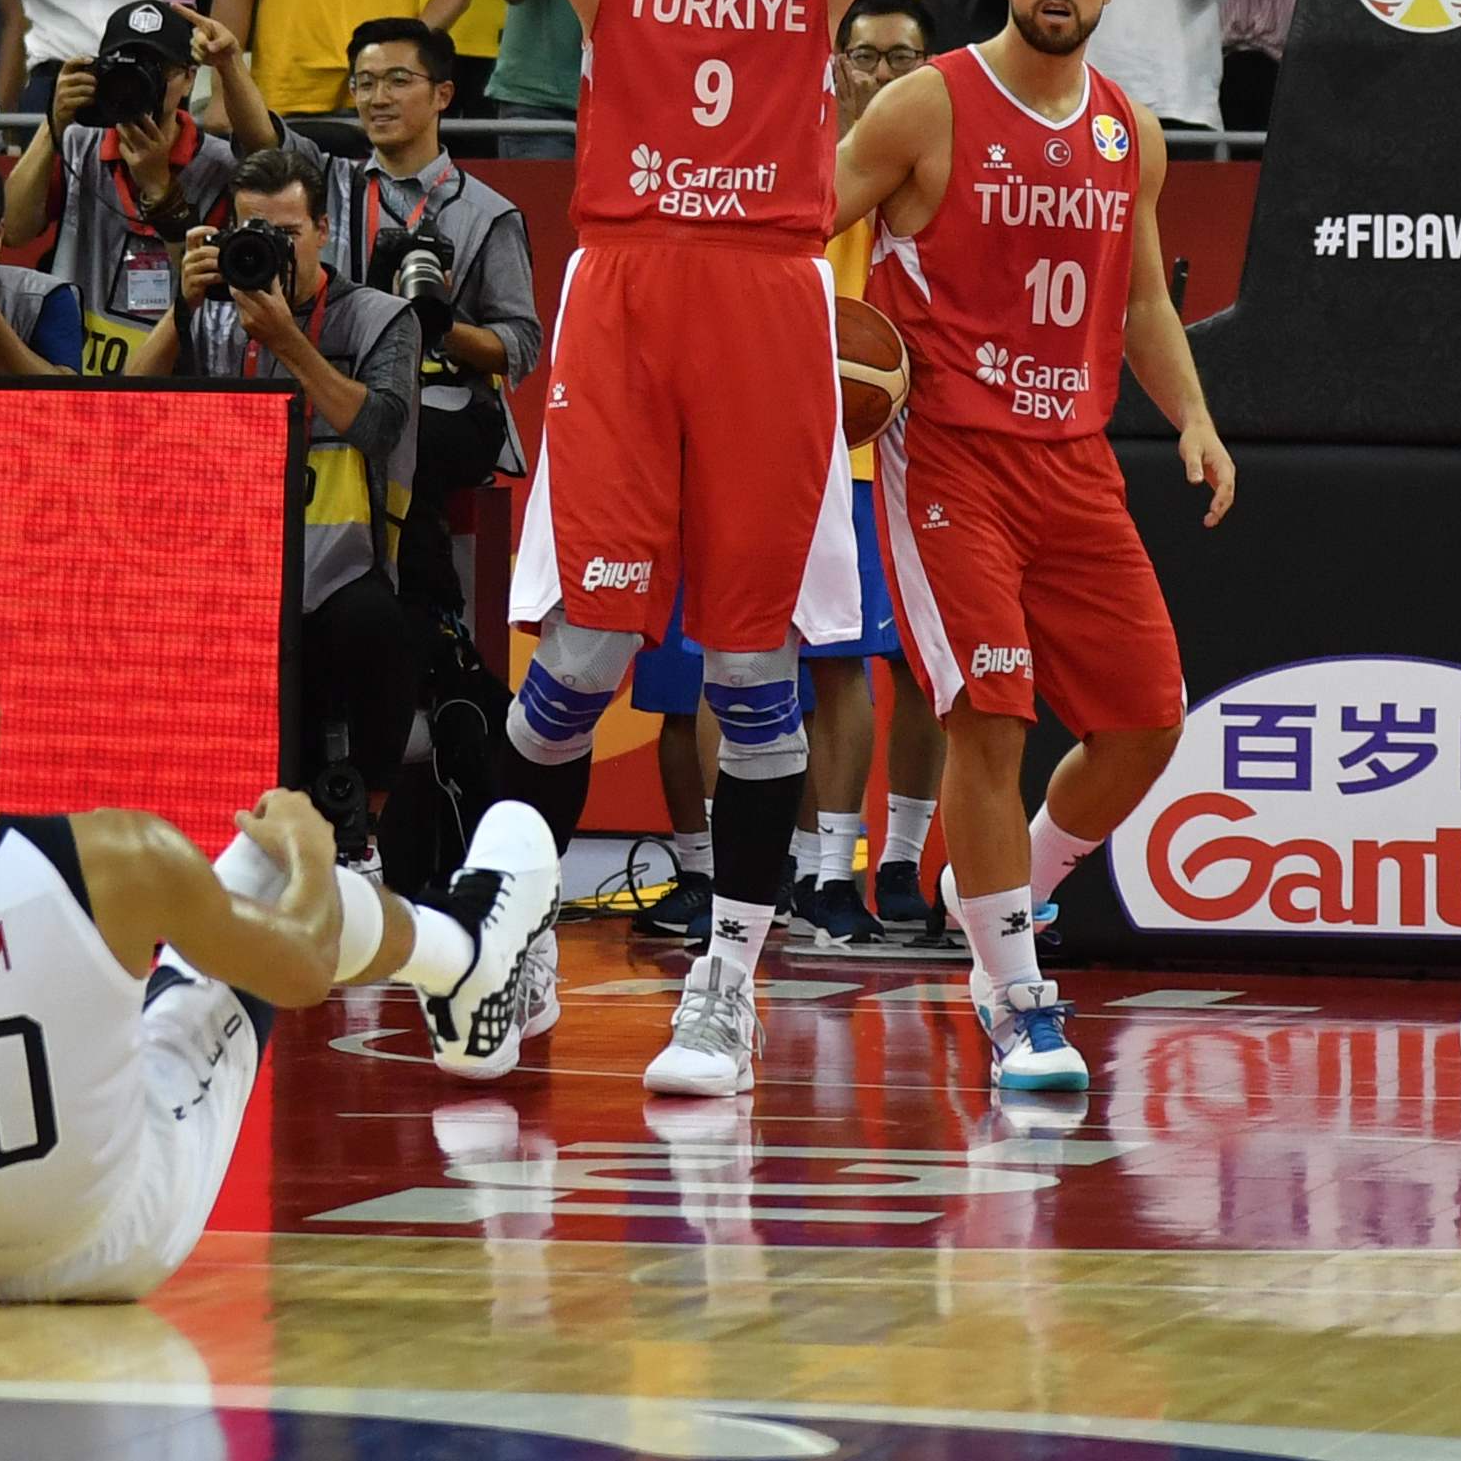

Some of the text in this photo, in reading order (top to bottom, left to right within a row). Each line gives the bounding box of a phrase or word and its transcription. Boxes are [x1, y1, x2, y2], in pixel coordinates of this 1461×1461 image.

[691, 58, 734, 128] 9
[658, 190, 747, 218] BBVA
[667, 157, 778, 194] Garanti
[974, 175, 1131, 233] TÜRKİYE
[1024, 257, 1087, 328] 10
